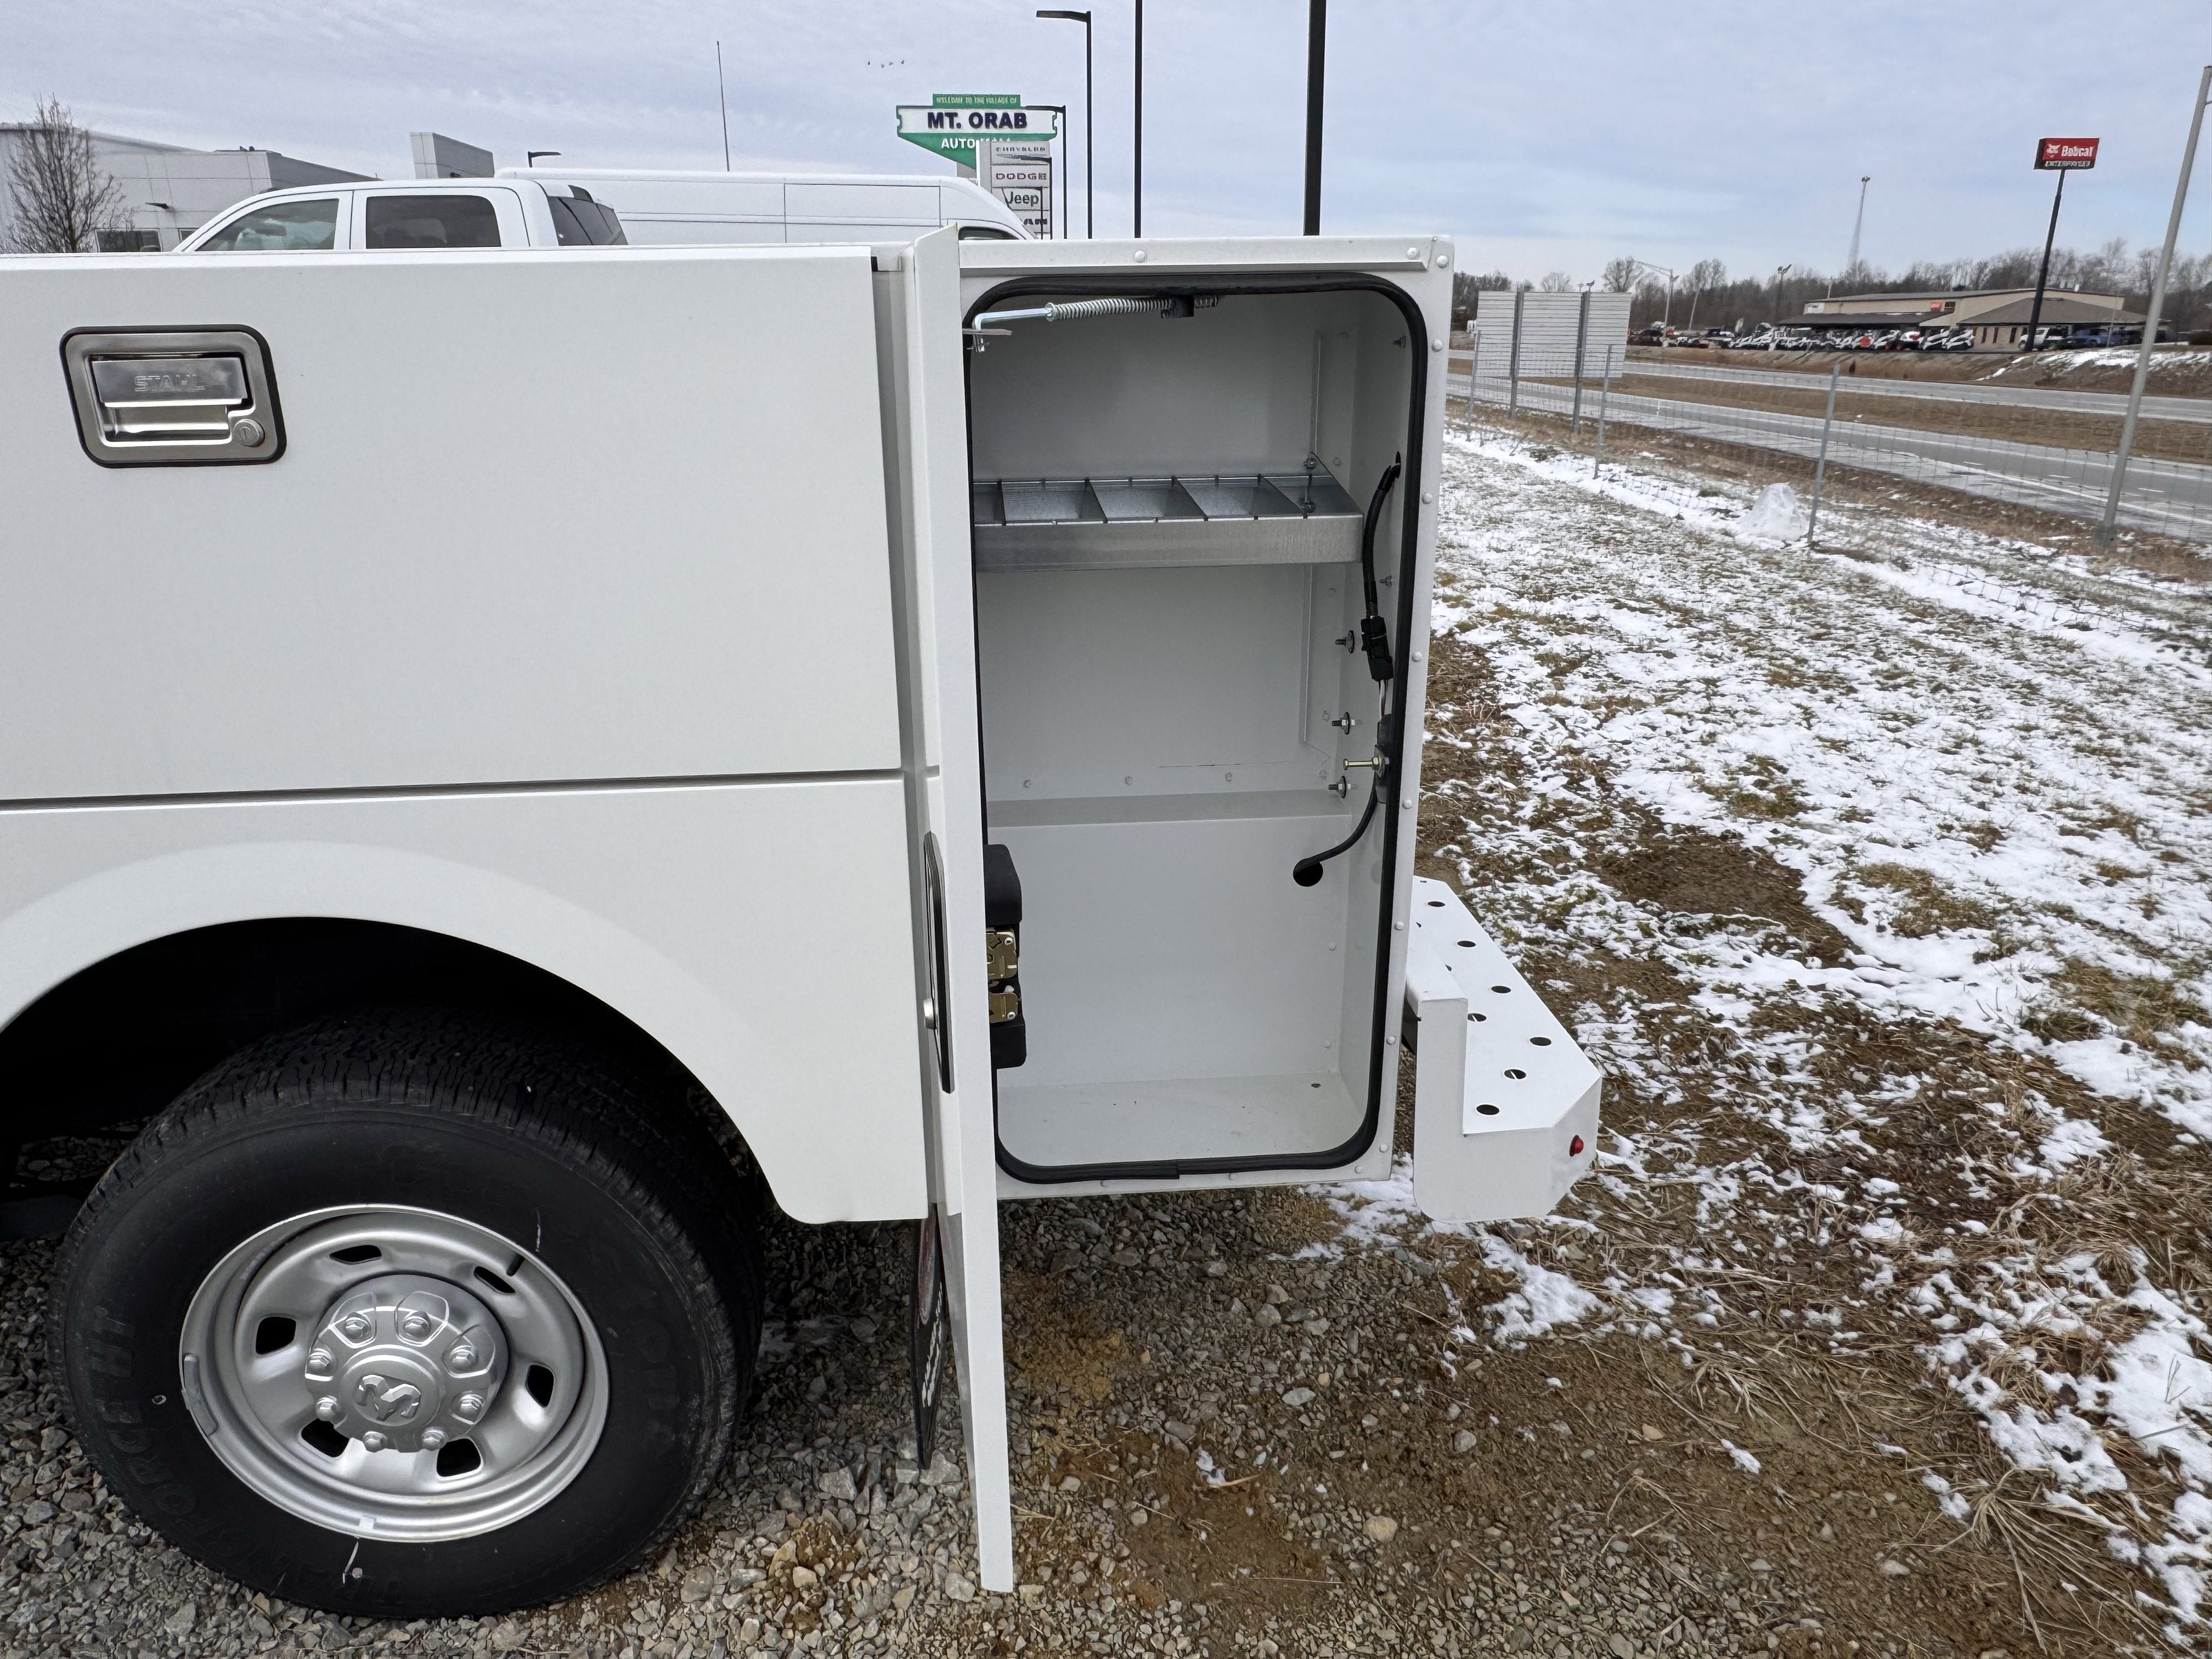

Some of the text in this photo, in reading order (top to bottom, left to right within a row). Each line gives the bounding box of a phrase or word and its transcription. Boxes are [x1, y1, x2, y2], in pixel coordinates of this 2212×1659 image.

[927, 112, 1028, 129] MT. ORAB
[2062, 146, 2094, 157] Bobcat
[1008, 191, 1039, 207] Jeep
[134, 374, 205, 392] STAHL
